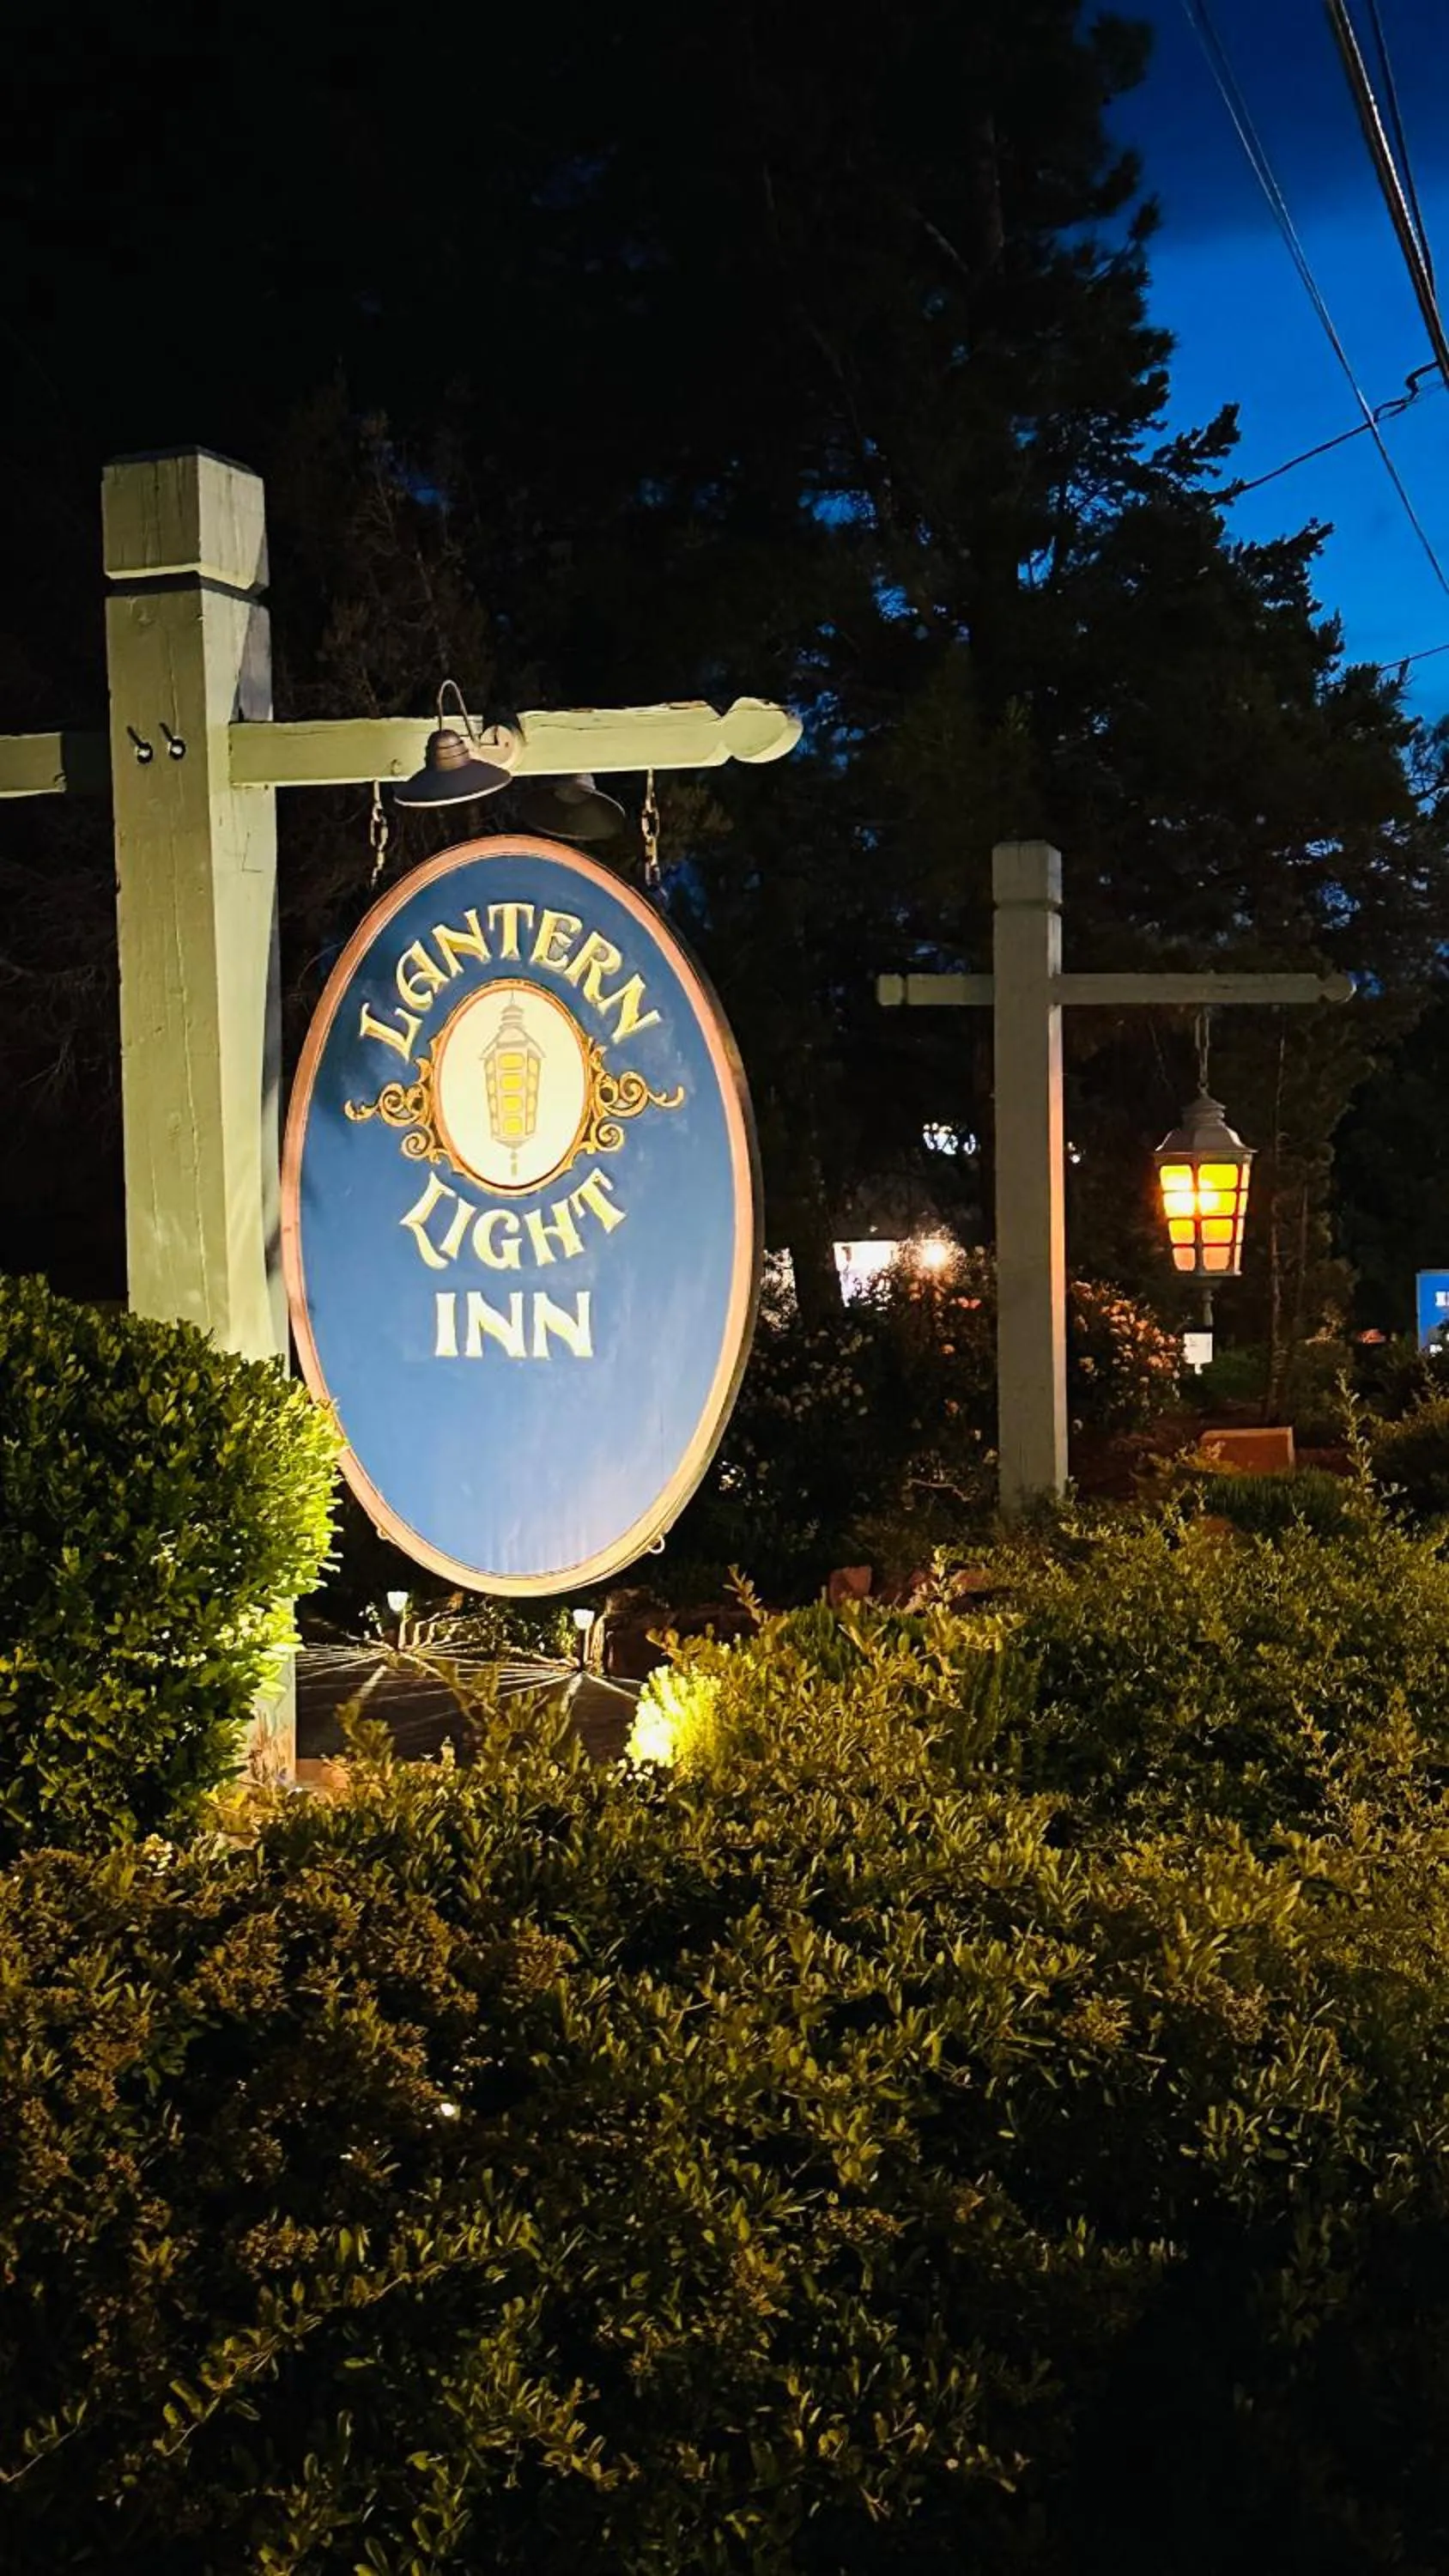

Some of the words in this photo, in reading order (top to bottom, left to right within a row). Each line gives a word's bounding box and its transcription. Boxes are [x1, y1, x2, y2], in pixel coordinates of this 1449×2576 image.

[359, 902, 661, 1063] LANTERN
[399, 1168, 627, 1270] LIGHT
[434, 1291, 594, 1358] INN
